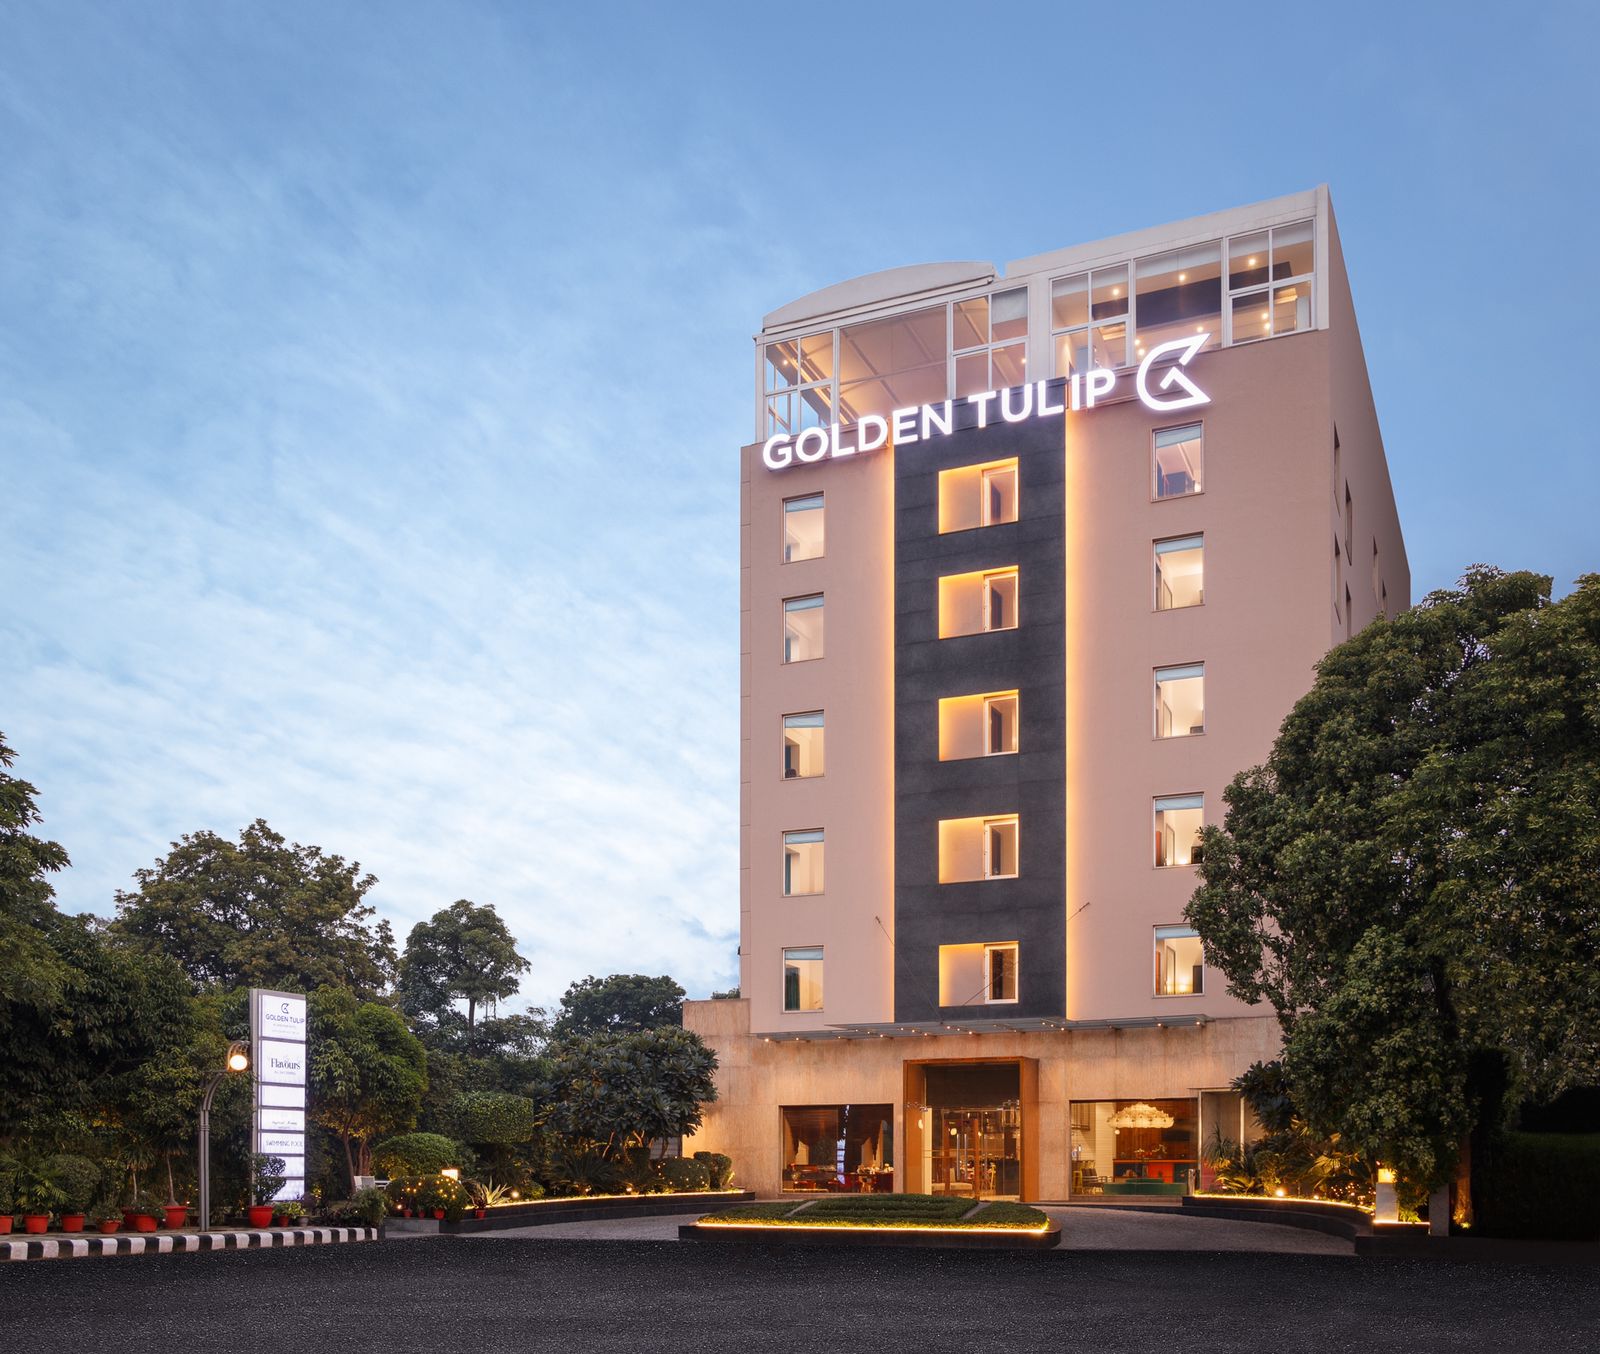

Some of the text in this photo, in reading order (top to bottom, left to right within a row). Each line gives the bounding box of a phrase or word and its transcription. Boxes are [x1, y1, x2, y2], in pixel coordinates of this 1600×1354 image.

[762, 368, 1116, 470] GOLDEN TULIP
[265, 1013, 305, 1025] GOLDEN TULIP
[271, 1057, 301, 1070] Flavours
